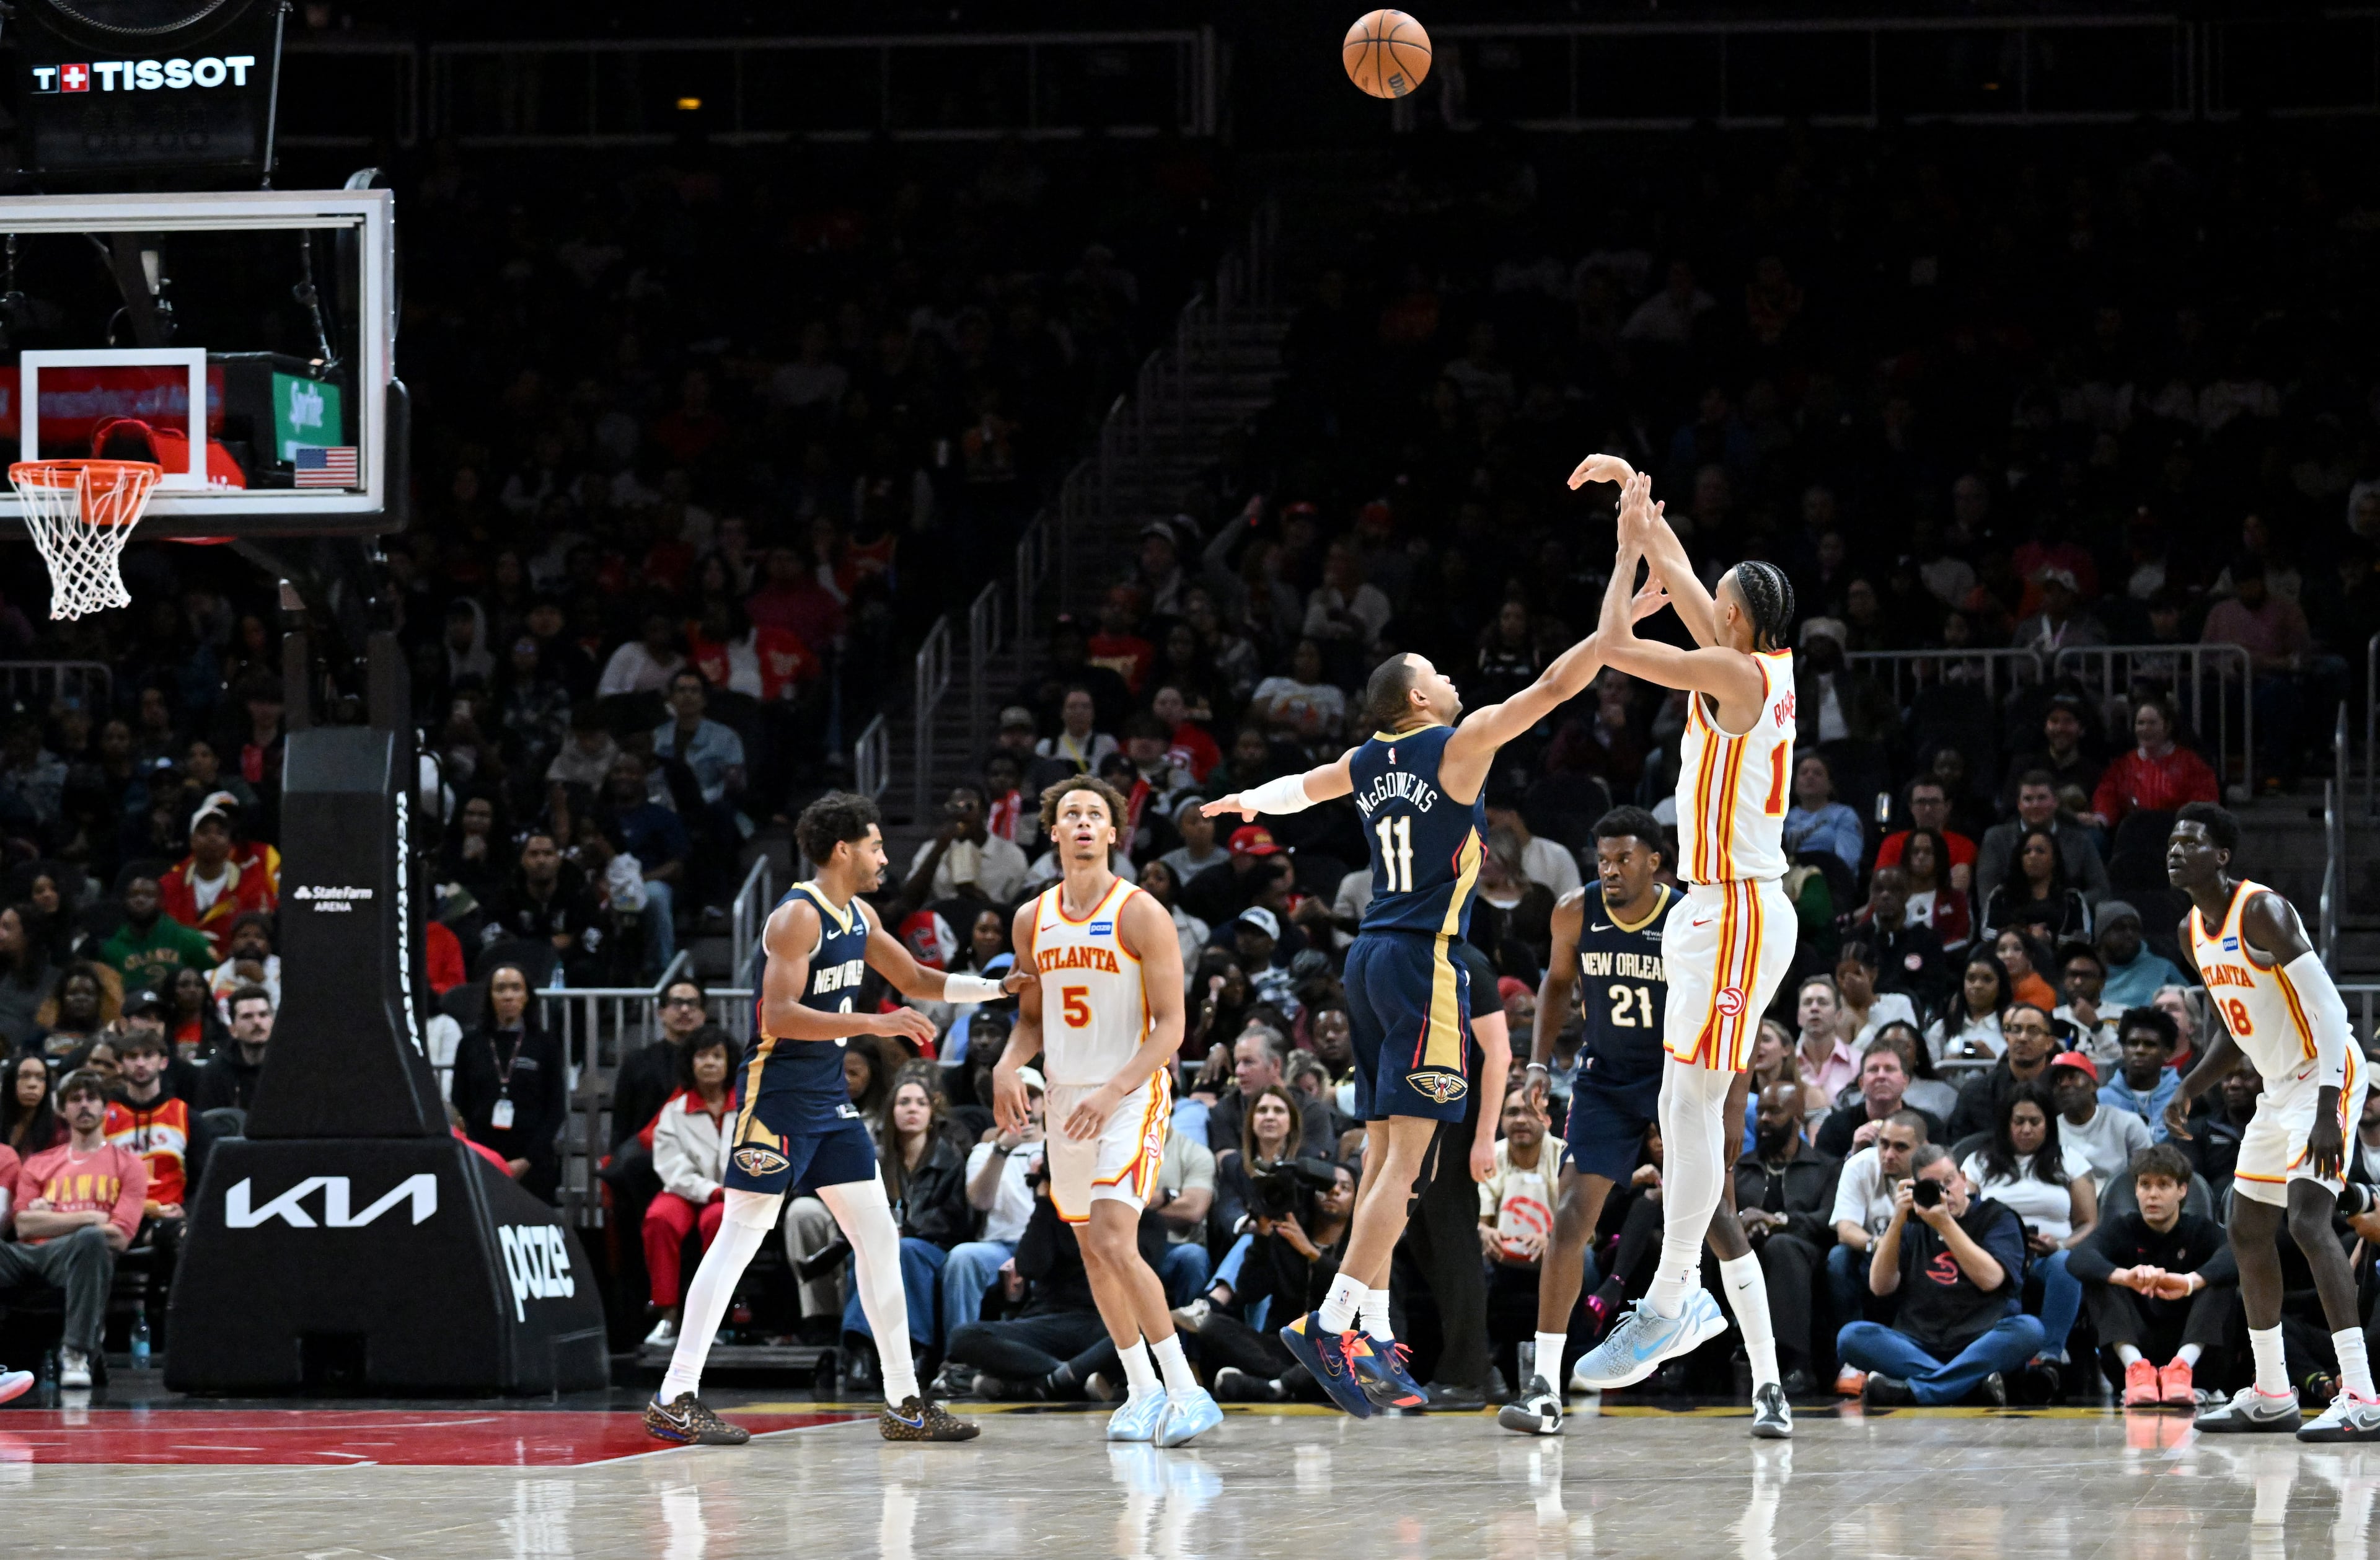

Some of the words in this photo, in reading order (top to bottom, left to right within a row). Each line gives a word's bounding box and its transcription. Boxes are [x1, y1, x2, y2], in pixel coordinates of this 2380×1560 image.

[93, 55, 255, 92] TISSOT
[1356, 772, 1437, 818] McGOWENS
[1765, 739, 1787, 817] 1
[1376, 816, 1413, 892] 11
[314, 901, 352, 912] ARENA
[813, 964, 845, 995] NEW
[1037, 946, 1121, 976] ATLANTA
[1581, 952, 1613, 976] NEW
[1062, 985, 1092, 1029] 5
[1608, 984, 1654, 1028] 21
[2218, 997, 2254, 1036] 18
[498, 1224, 575, 1323] paze
